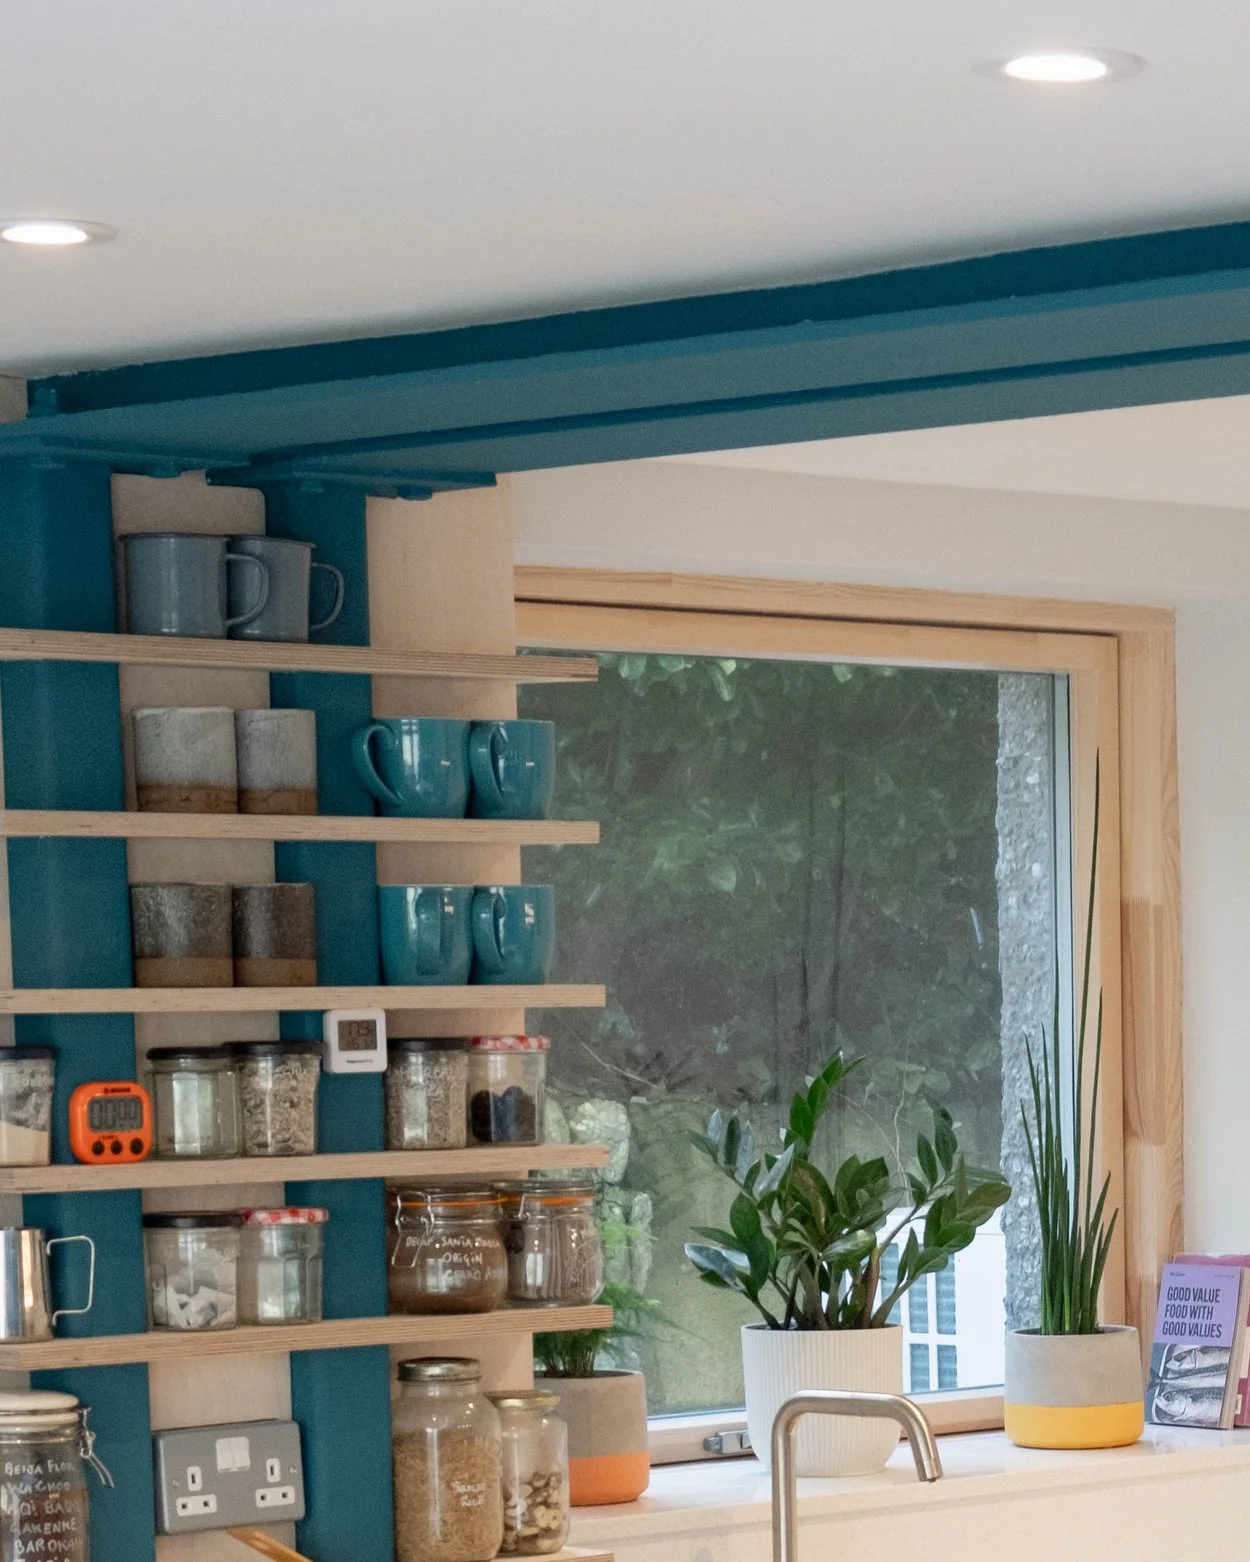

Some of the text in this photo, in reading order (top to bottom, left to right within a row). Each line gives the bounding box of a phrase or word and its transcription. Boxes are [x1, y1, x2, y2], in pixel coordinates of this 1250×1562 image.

[1167, 1286, 1221, 1303] GOOD VALUE
[1164, 1304, 1214, 1320] FOOD WITH
[1162, 1321, 1223, 1338] GOOD VALUES
